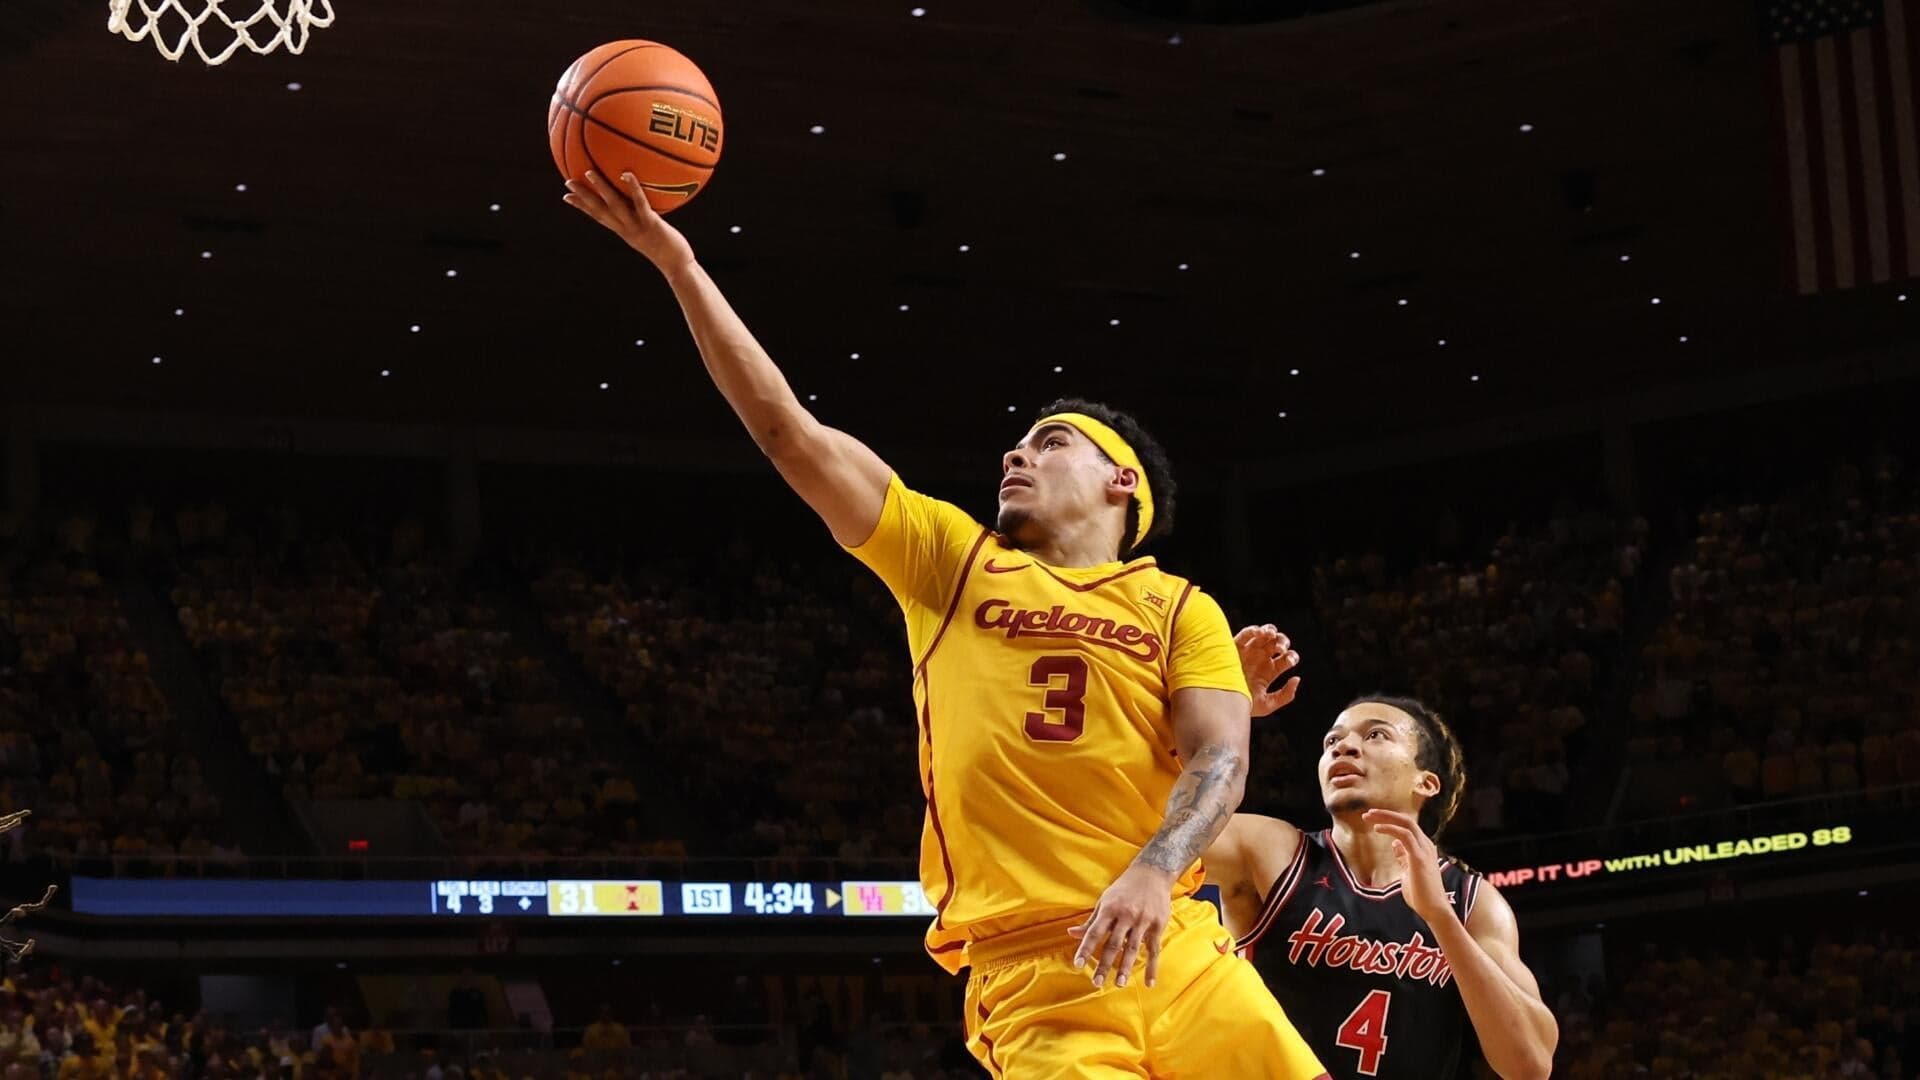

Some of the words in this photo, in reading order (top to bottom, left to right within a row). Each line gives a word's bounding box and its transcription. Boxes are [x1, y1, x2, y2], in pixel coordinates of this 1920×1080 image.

[649, 109, 719, 153] ELITE
[974, 598, 1160, 663] Cyclones
[1022, 655, 1089, 744] 3
[1537, 864, 1563, 882] IT
[1565, 859, 1602, 878] UP
[1604, 853, 1661, 873] WITH
[1663, 832, 1808, 866] UNLEADED
[1812, 826, 1852, 846] 88
[558, 884, 599, 912] 31
[689, 889, 723, 908] 1ST
[744, 882, 815, 914] 4:34
[1288, 907, 1453, 989] Houston
[1335, 989, 1391, 1077] 4
